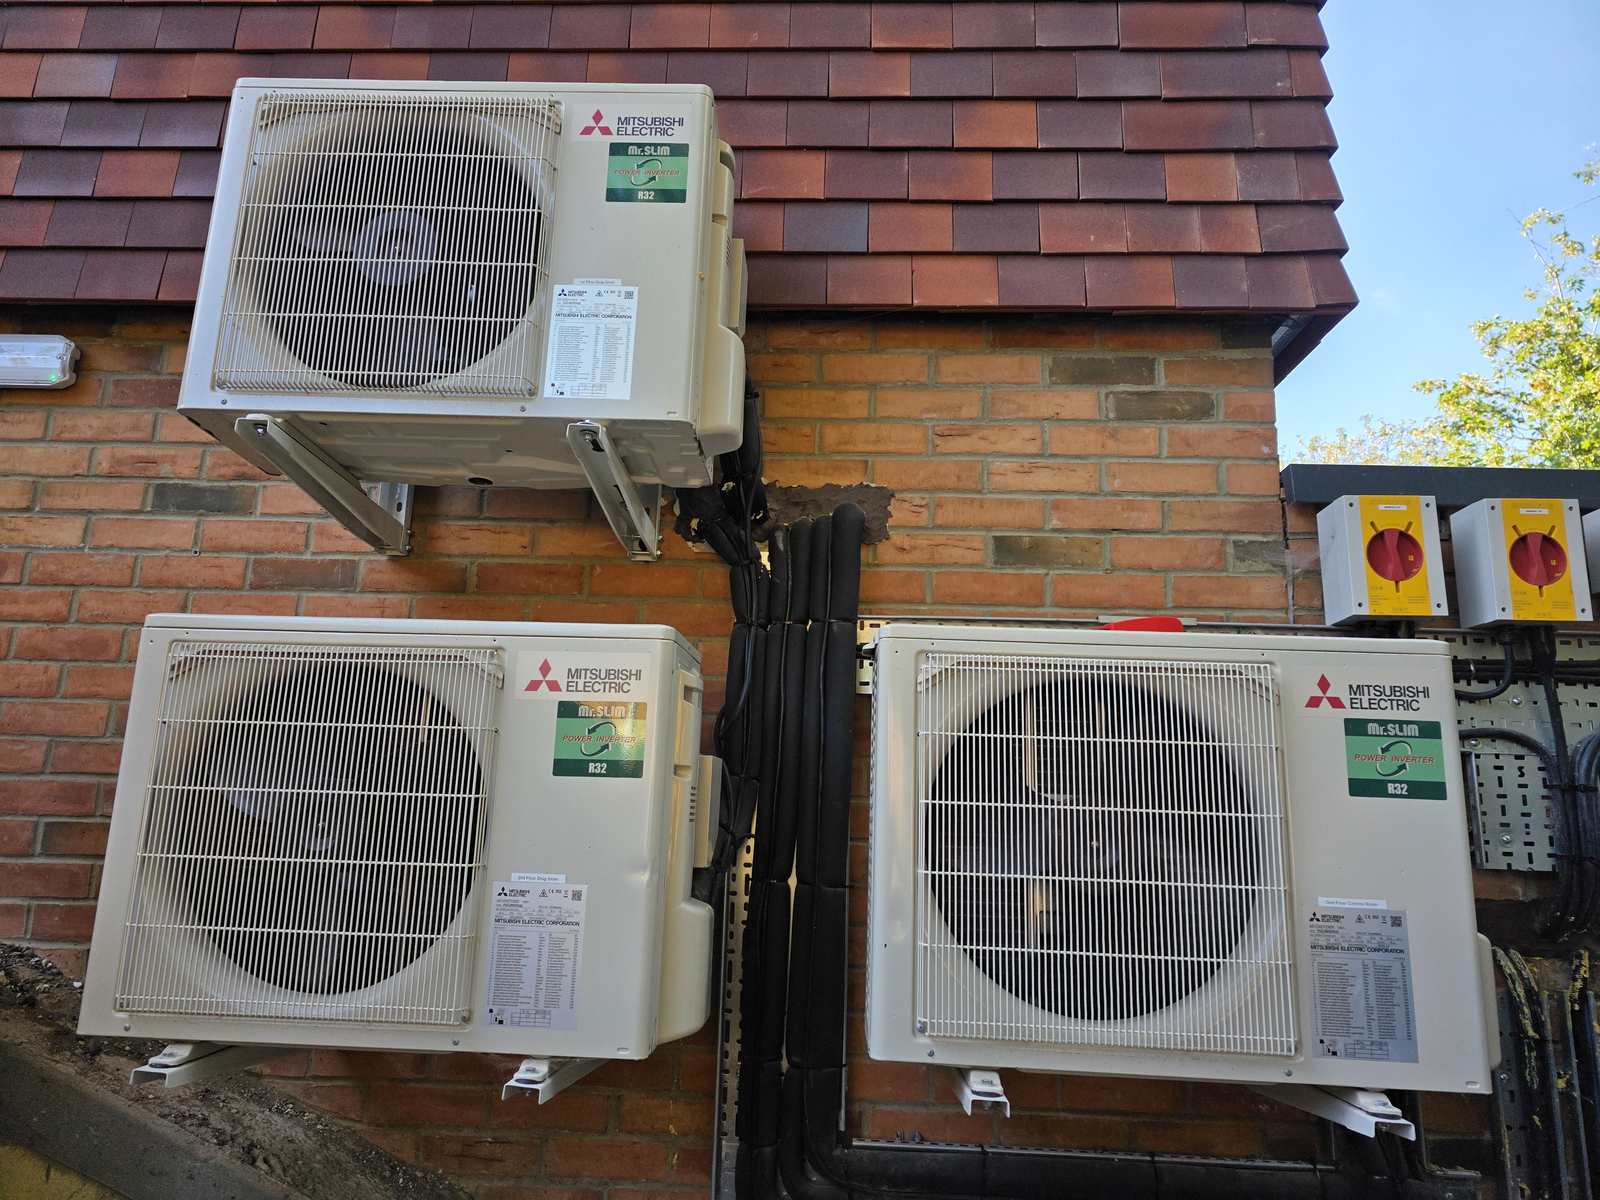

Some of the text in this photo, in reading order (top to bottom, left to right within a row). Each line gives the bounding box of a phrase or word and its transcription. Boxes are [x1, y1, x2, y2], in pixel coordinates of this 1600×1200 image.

[617, 116, 684, 126] MITSUBISHI
[616, 127, 675, 137] ELECTRIC
[637, 190, 655, 200] R32
[567, 667, 642, 681] MITSUBISHI
[566, 681, 632, 694] ELECTRIC
[1348, 684, 1430, 699] MITSUBISHI
[1350, 697, 1421, 712] ELECTRIC
[561, 735, 637, 743] POWER INVERTER
[1354, 753, 1434, 764] POWER INVERTER
[588, 762, 608, 774] R32
[1387, 783, 1408, 795] R32
